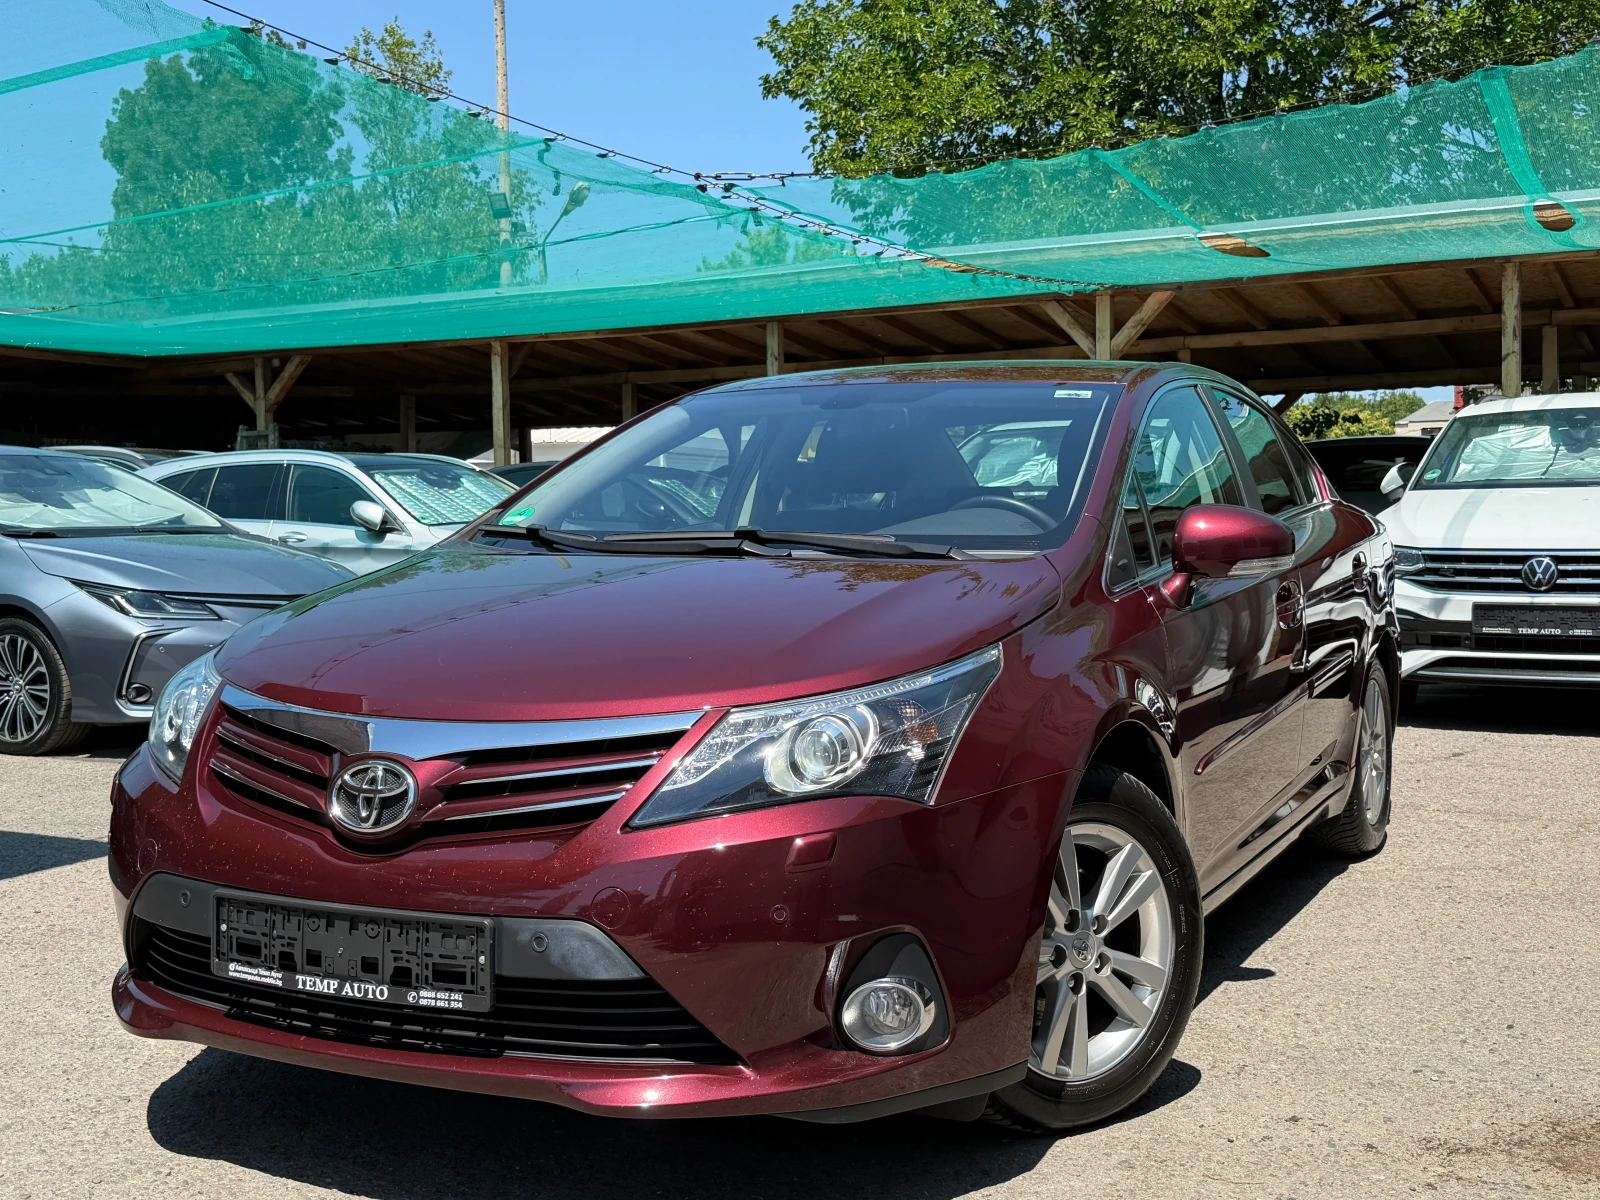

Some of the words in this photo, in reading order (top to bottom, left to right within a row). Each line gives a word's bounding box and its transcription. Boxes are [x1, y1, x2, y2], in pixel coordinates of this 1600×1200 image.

[295, 974, 338, 994] TEMP
[341, 982, 389, 1000] AUTO
[419, 990, 436, 998] 0888
[450, 993, 463, 1001] 241
[419, 998, 436, 1006] 0878
